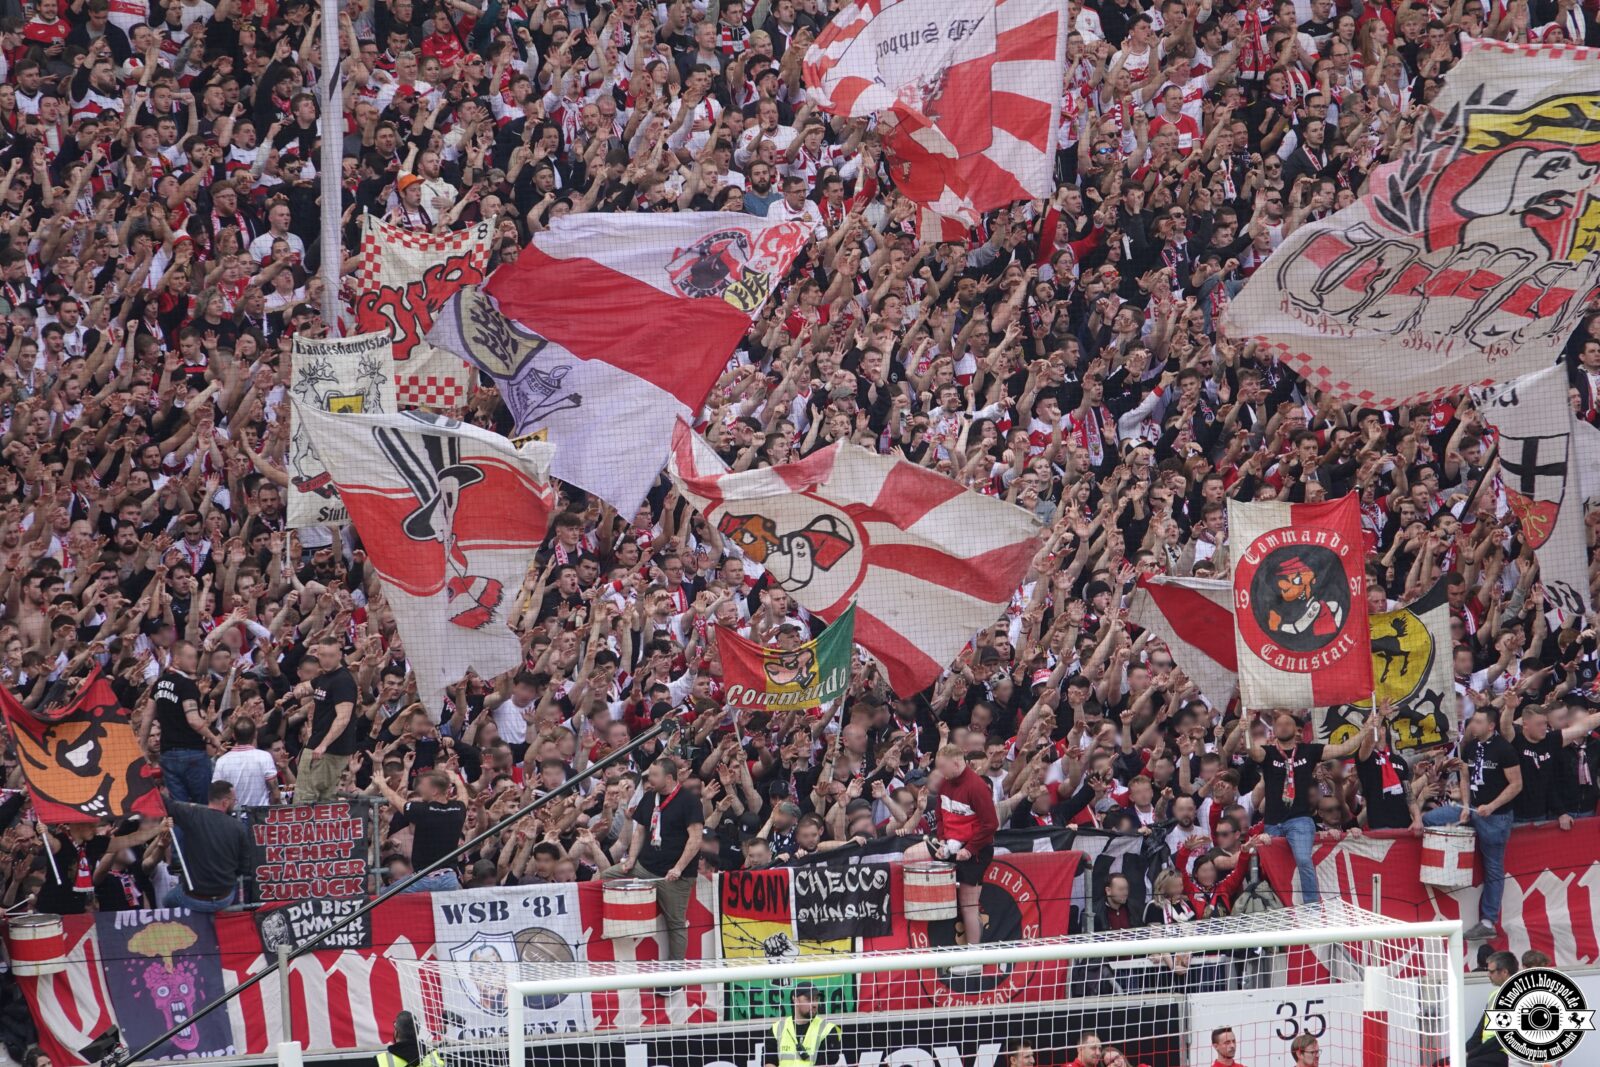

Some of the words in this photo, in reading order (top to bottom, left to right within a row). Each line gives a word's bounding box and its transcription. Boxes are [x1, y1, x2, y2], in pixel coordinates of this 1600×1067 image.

[477, 223, 488, 240] 8
[1244, 529, 1350, 565] Commando
[1234, 588, 1250, 609] 19
[1350, 575, 1362, 597] 97
[1260, 633, 1356, 671] Cannstatt
[726, 667, 846, 706] Commando
[1328, 713, 1442, 754] 011
[265, 803, 350, 824] JEDER
[253, 817, 364, 847] VERBANNTE
[265, 841, 355, 863] KEHRT
[795, 866, 889, 901] CHECCO
[988, 866, 1030, 903] ando
[287, 901, 314, 922] DU
[321, 899, 364, 916] BIST
[441, 900, 510, 925] WSB
[323, 932, 367, 946] UNS!
[911, 931, 929, 948] 19
[735, 982, 850, 1020] CESA
[1275, 999, 1327, 1041] 35
